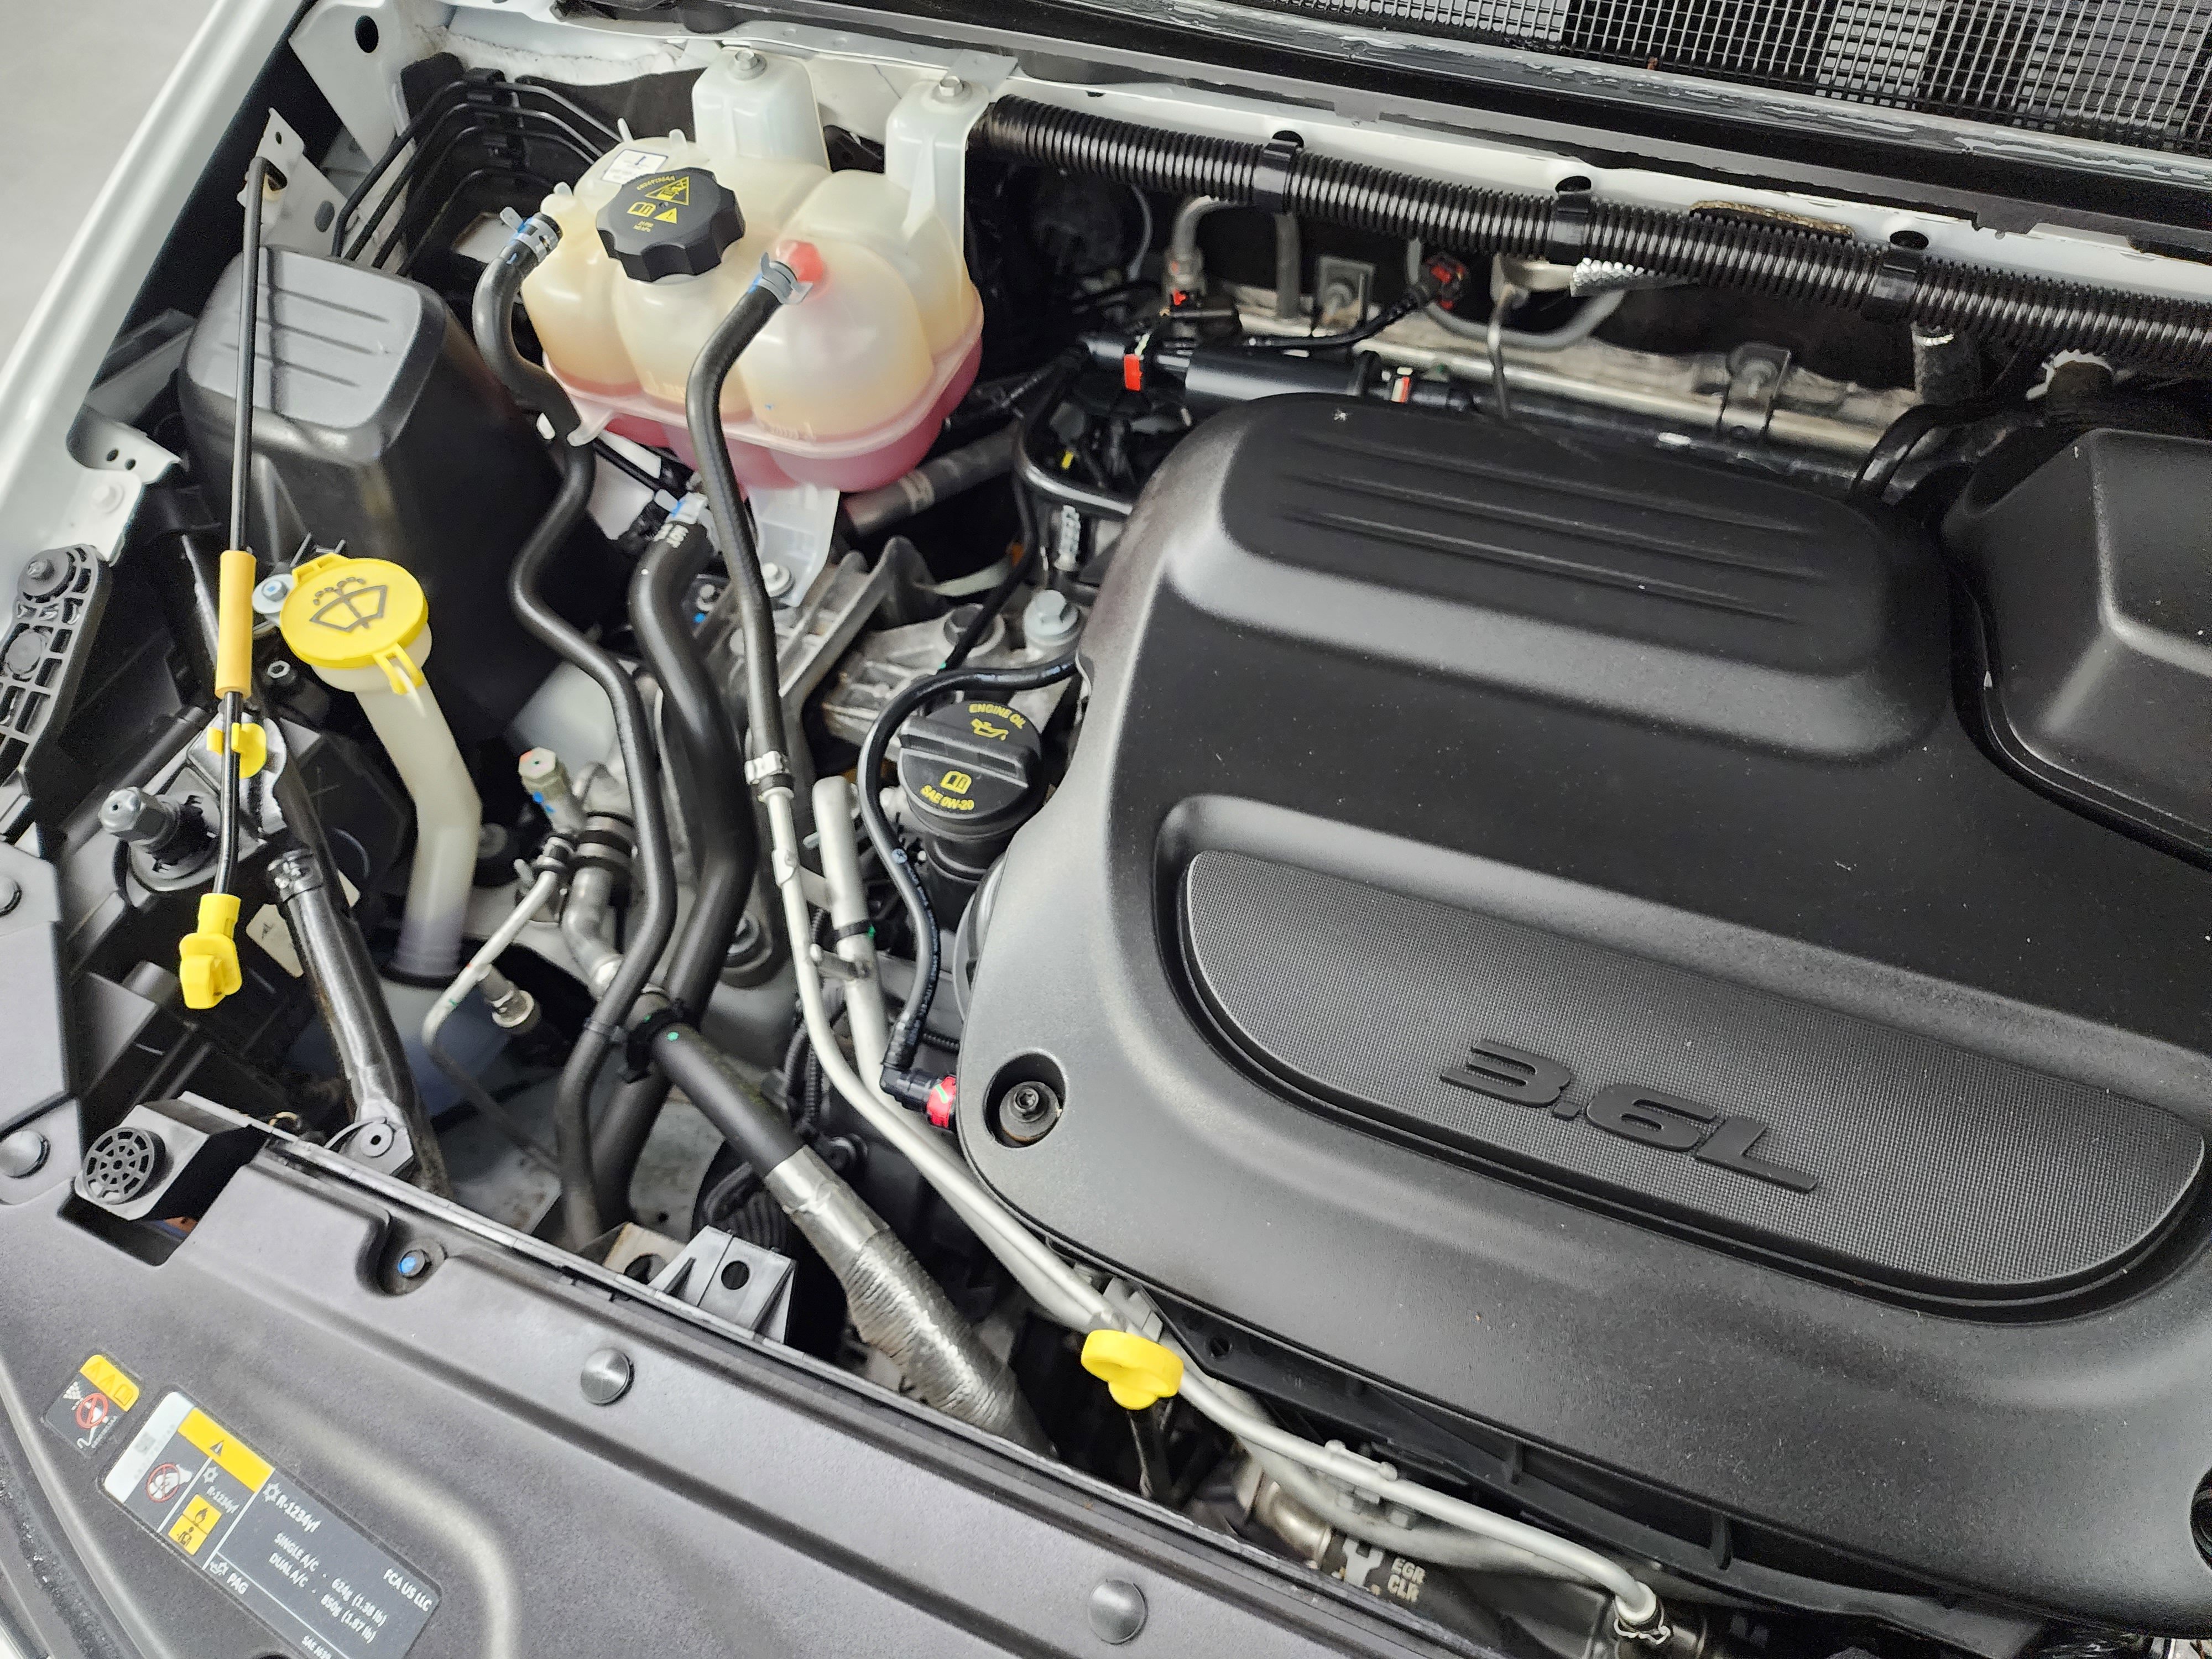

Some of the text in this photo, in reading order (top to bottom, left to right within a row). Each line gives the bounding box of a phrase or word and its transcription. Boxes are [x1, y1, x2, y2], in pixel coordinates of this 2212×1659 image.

[969, 703, 1026, 729] ENGINE OIL
[920, 785, 974, 811] SAE 0W-20
[1439, 1039, 1818, 1194] 3.6L
[275, 1494, 322, 1533] R-1234yf
[274, 1532, 305, 1561] SINGLE
[300, 1553, 319, 1572] A/C
[226, 1573, 249, 1595] PAG
[269, 1552, 293, 1576] DUAL
[289, 1569, 309, 1588] A/C
[1391, 1557, 1426, 1584] EGR
[383, 1568, 432, 1612] FCA US LLC
[302, 1635, 317, 1651] SAE
